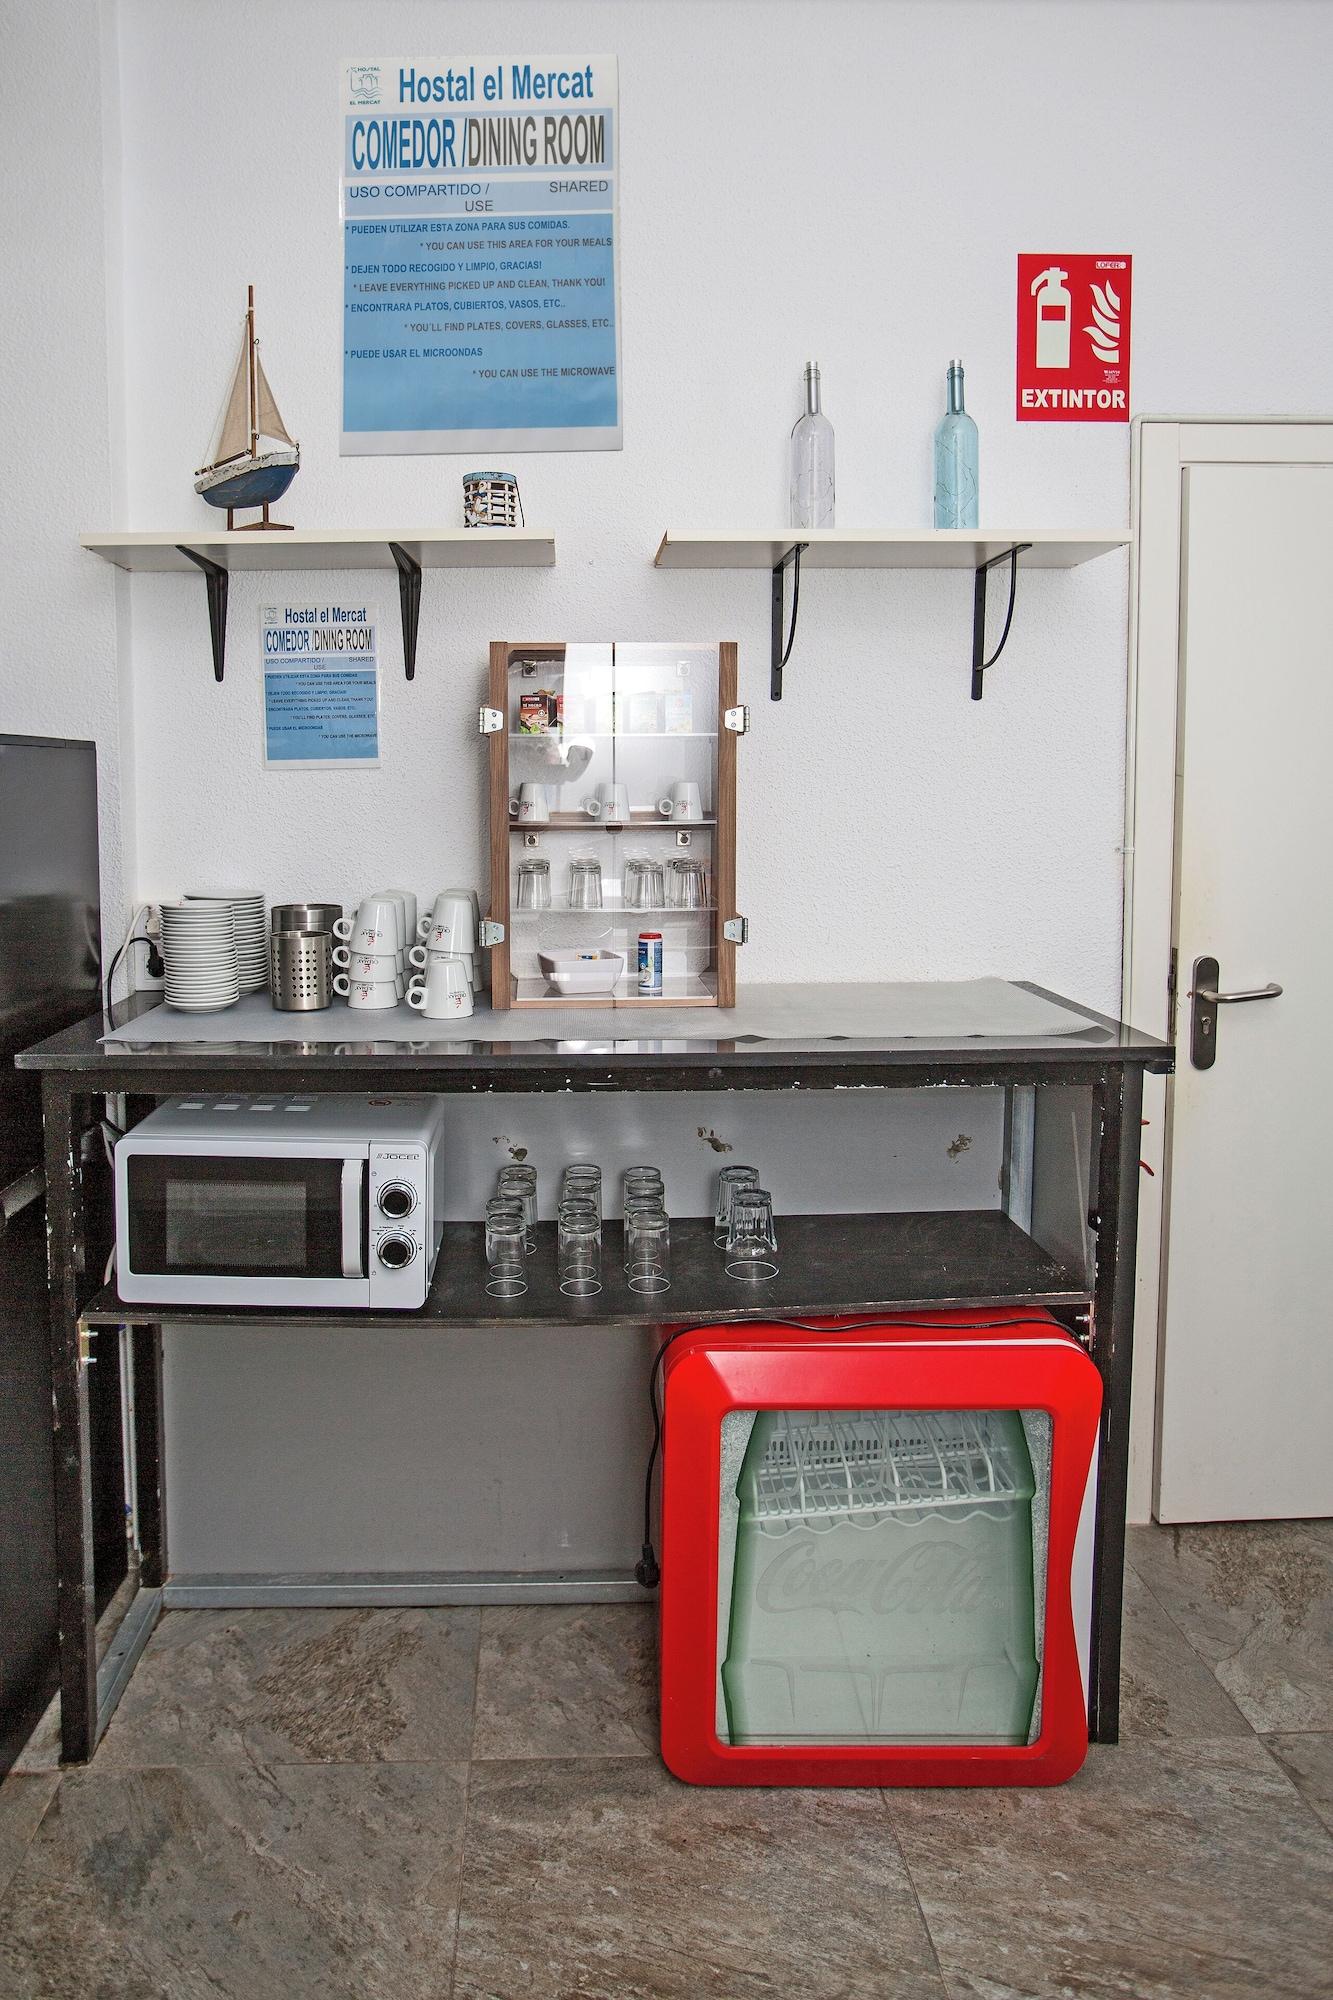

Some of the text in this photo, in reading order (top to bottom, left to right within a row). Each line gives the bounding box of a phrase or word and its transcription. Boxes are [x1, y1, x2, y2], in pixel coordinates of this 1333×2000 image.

[400, 64, 593, 103] Hostal el Mercat
[352, 118, 455, 170] COMEDOR
[544, 115, 605, 165] ROOM
[350, 186, 380, 198] USO
[384, 183, 481, 197] COMPARTIDO
[549, 180, 608, 193] SHARED
[465, 200, 493, 212] USE
[351, 220, 570, 234] PUEDEN UTILIZAR ESTA ZONA PARA SUS COMIDAS.
[426, 237, 612, 251] YOU CAN USE THIS AREA FOR YOUR MEALS
[351, 261, 542, 274] DEJEN TODO RECOGIDO Y LIMPIO, GRACIAS!
[359, 277, 605, 292] LEAVE EVERYTHING PICKED UP AND CLEAN, THANK YOU!
[414, 301, 451, 312] PLATOS,
[453, 300, 507, 311] CUBIERTOS,
[509, 300, 541, 309] VASOS,
[444, 322, 465, 331] FIND
[467, 321, 503, 331] PLATES,
[505, 320, 544, 330] COVERS,
[546, 319, 590, 329] GLASSES,
[351, 348, 483, 359] PUEDE USAR EL MICROONDAS
[479, 366, 615, 378] YOU CAN USE THE MICROWAVE
[1021, 388, 1126, 409] EXTINTOR
[285, 607, 366, 623] Hostal el Mercat
[266, 629, 309, 652] COMEDOR
[346, 629, 371, 650] ROOM
